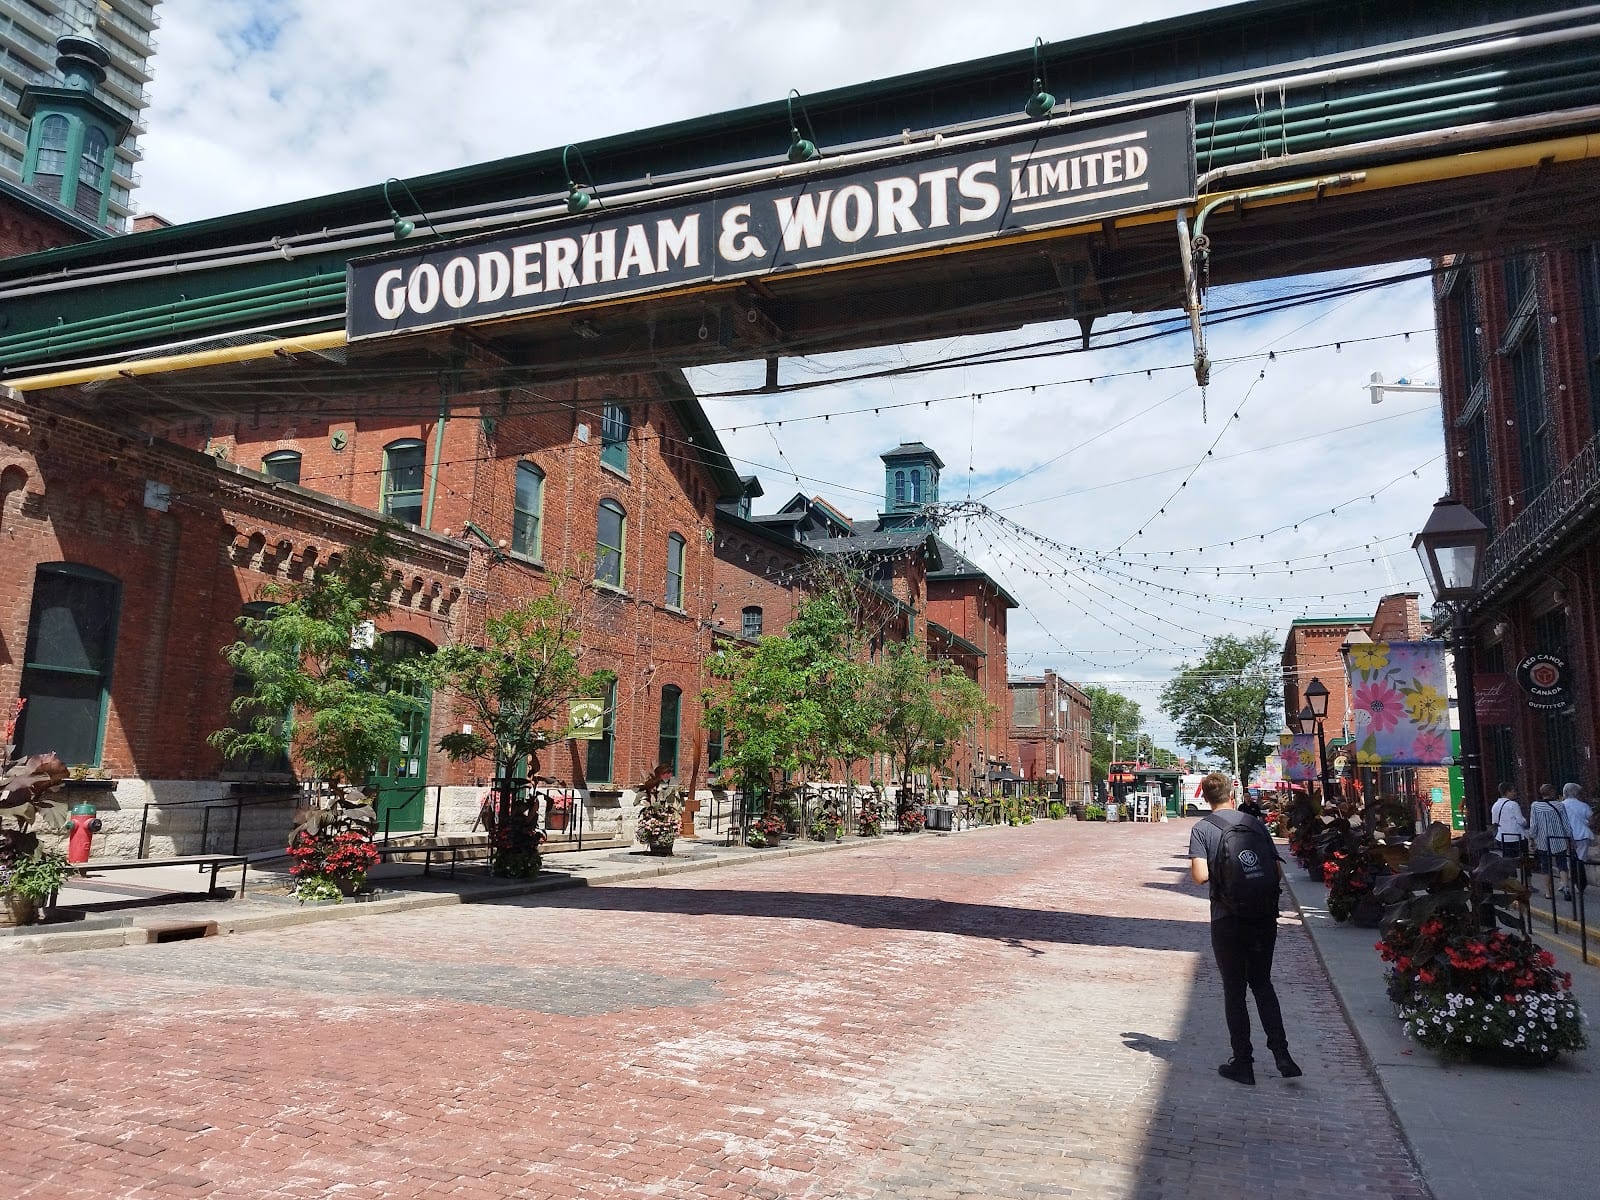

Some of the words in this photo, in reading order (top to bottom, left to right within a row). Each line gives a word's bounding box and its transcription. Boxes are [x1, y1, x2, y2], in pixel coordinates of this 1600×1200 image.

[1009, 145, 1150, 199] LIMITED
[374, 213, 702, 321] GOODERHAM
[718, 203, 767, 263] &
[774, 159, 1001, 252] WORTS
[1522, 656, 1536, 669] RED
[1537, 654, 1565, 668] CANOE
[1530, 686, 1563, 696] CANADA
[1528, 701, 1567, 710] OUTFITTER
